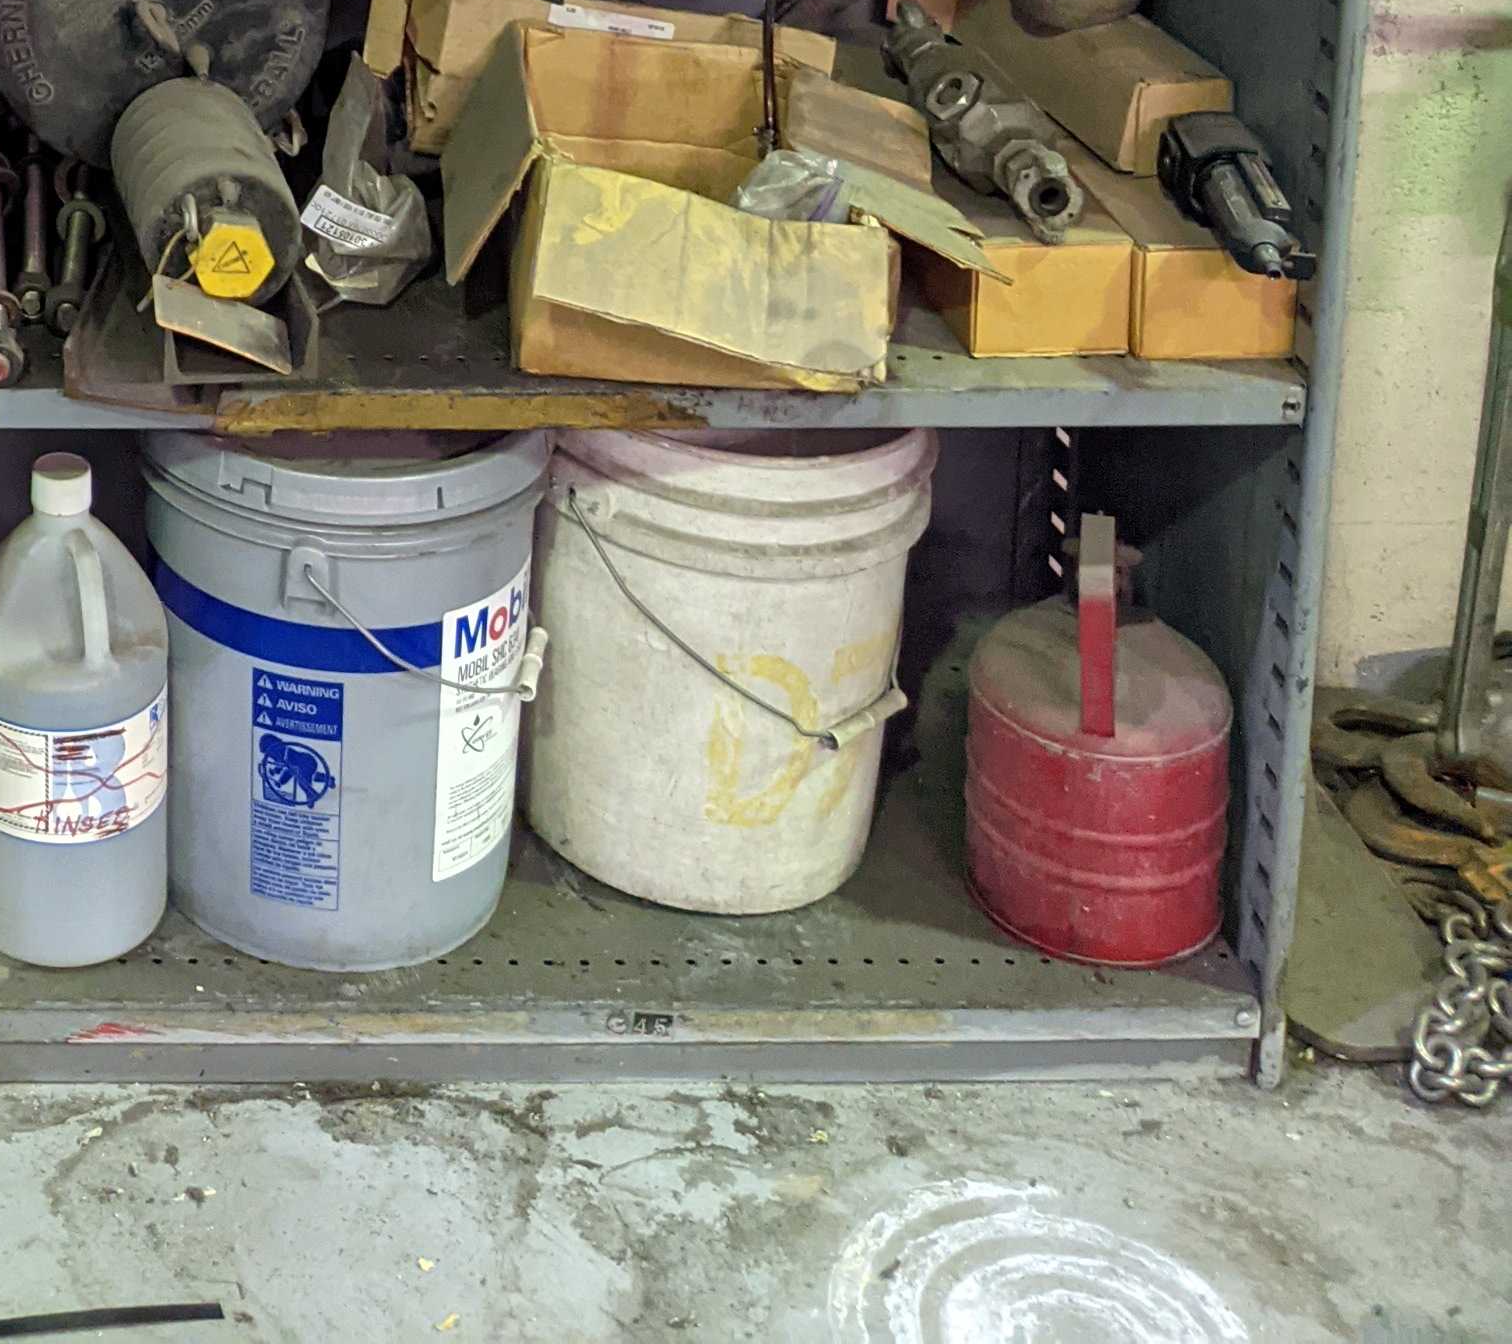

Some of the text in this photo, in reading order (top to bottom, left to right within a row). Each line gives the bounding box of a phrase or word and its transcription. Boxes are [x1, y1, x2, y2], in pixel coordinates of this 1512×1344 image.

[454, 586, 526, 659] Mob
[457, 653, 490, 683] MOBIL
[276, 679, 340, 699] WARNING
[276, 699, 318, 715] AVISO
